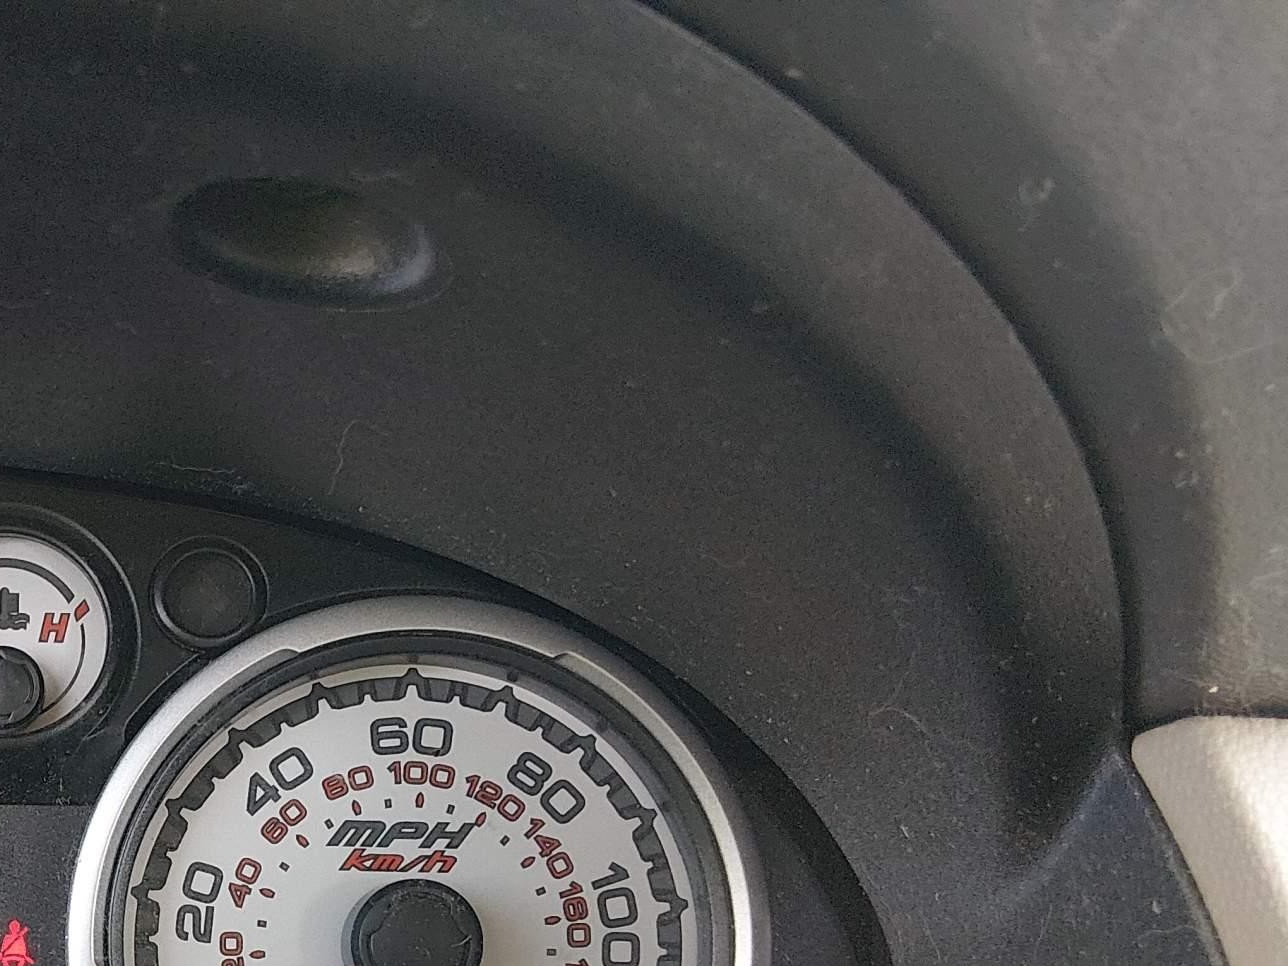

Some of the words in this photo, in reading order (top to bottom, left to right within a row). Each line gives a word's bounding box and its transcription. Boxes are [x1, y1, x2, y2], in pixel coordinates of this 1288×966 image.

[38, 612, 71, 644] H
[369, 716, 454, 757] 60
[246, 747, 314, 816] 40
[387, 761, 456, 789] 100
[465, 774, 526, 822] 120
[507, 751, 586, 824] 80
[325, 820, 476, 849] MPH
[524, 817, 574, 879] 140
[228, 857, 262, 908] 40
[338, 848, 458, 873] km/h
[175, 861, 224, 943] 20
